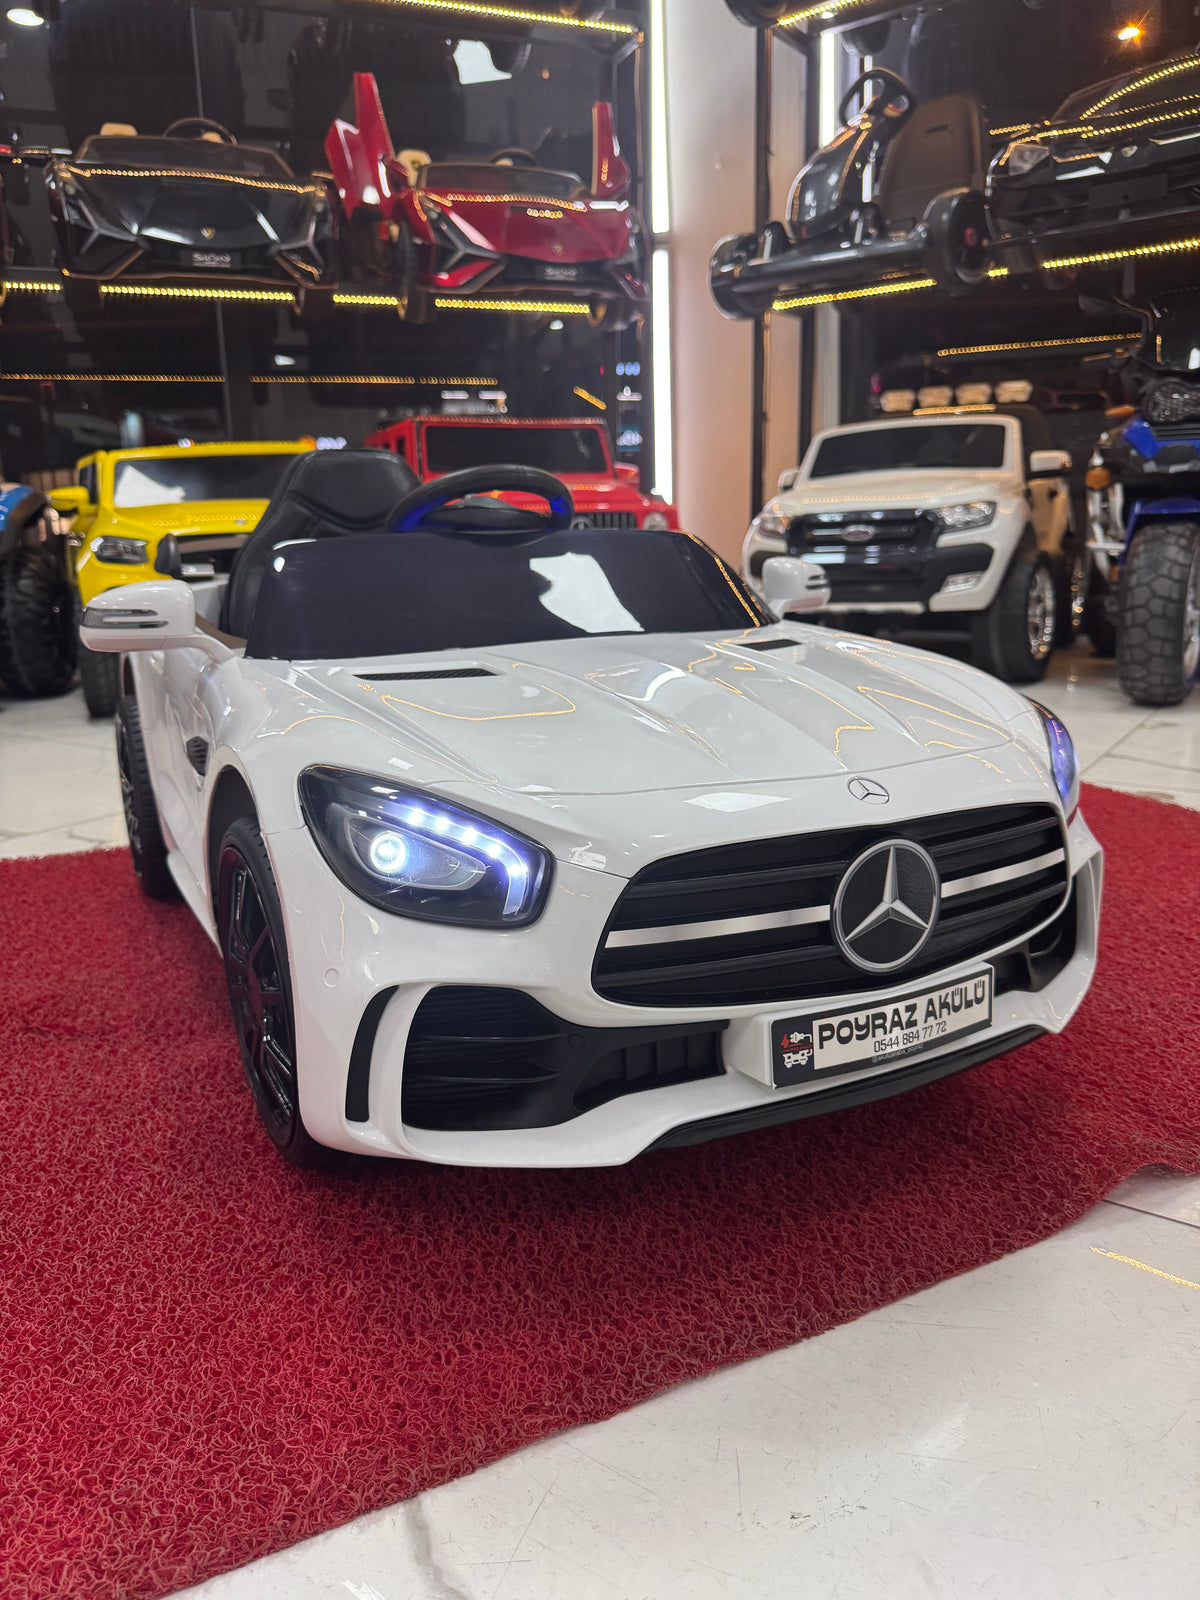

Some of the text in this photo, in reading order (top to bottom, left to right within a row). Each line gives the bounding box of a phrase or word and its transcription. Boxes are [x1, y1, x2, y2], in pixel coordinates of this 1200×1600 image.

[818, 979, 986, 1050] POYRAZ AKÜLÜ
[873, 1021, 947, 1053] 0544 884 77 72
